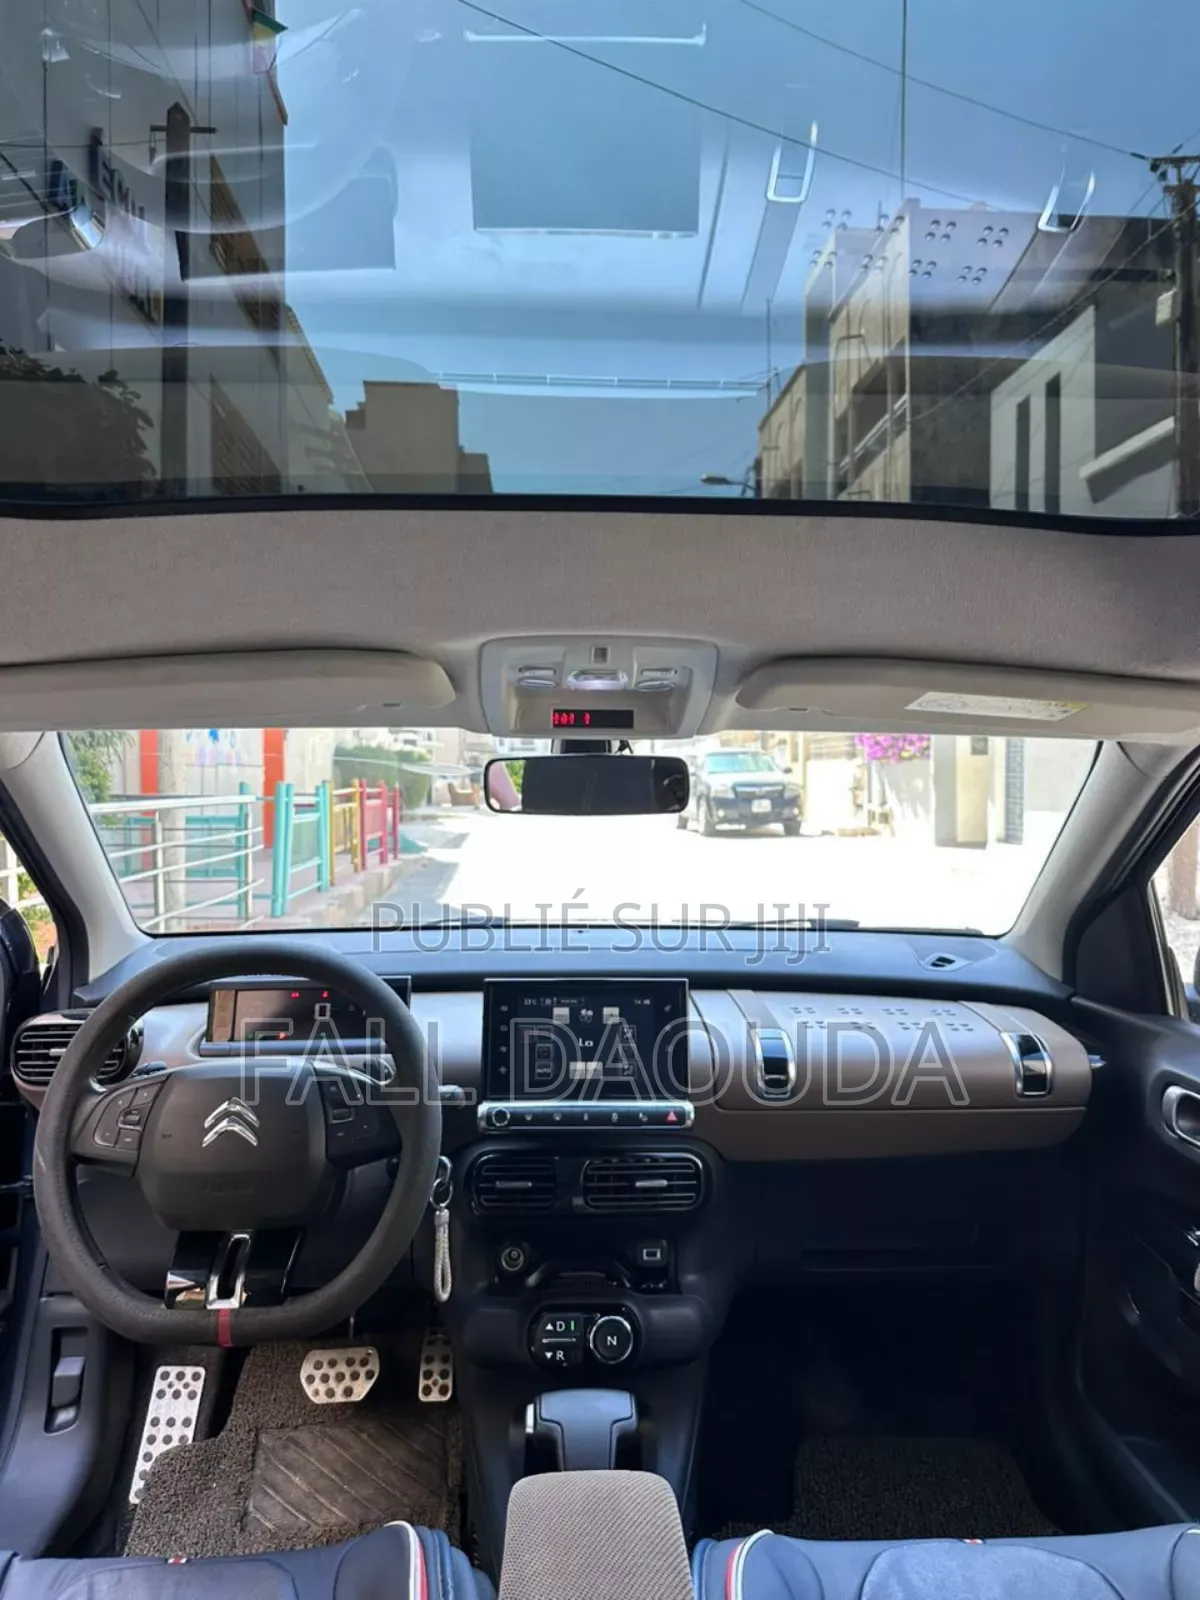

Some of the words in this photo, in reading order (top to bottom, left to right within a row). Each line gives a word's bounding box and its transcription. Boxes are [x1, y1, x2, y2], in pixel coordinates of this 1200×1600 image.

[556, 1321, 566, 1331] D
[606, 1336, 618, 1346] N
[555, 1351, 565, 1361] R
